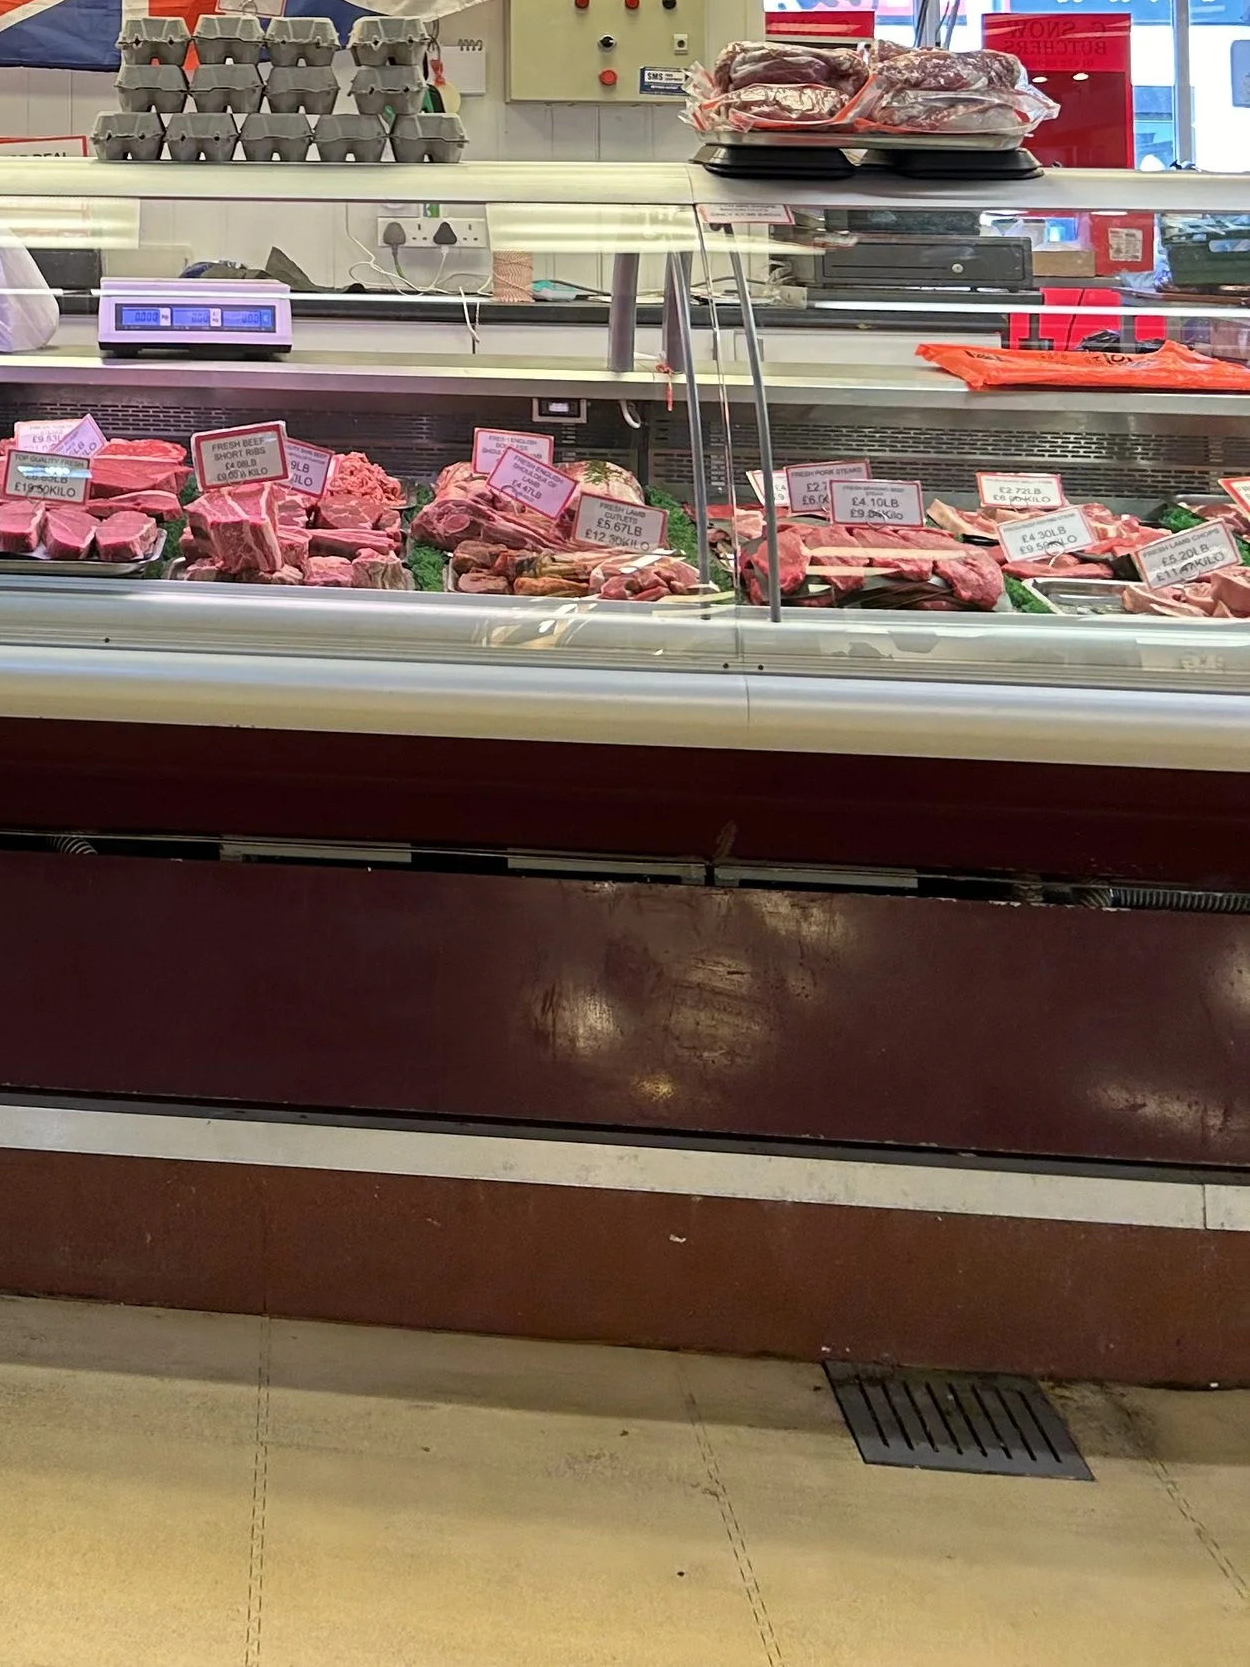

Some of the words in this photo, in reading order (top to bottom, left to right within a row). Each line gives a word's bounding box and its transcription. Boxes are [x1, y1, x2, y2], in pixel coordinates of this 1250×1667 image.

[647, 72, 664, 81] SMS
[212, 441, 241, 452] FRESH
[242, 436, 265, 447] BEEF
[14, 454, 29, 462] TOP
[30, 456, 61, 465] QUALITY
[214, 450, 245, 462] SHORT
[245, 446, 266, 457] RIBS
[248, 466, 268, 477] KILO
[290, 460, 310, 474] 9LB
[512, 462, 548, 484] SHOULDER
[513, 455, 536, 472] FRESH
[534, 466, 565, 484] ENGLISH
[521, 476, 541, 489] LAMB
[999, 486, 1042, 495] £2.72LB
[600, 502, 627, 514] FRESH
[852, 497, 900, 508] £4.10LB
[604, 511, 639, 525] CUTLETS
[596, 517, 643, 536] £5.67LB
[1021, 526, 1067, 544] £4.30LB
[1161, 543, 1210, 567] £5.20LB
